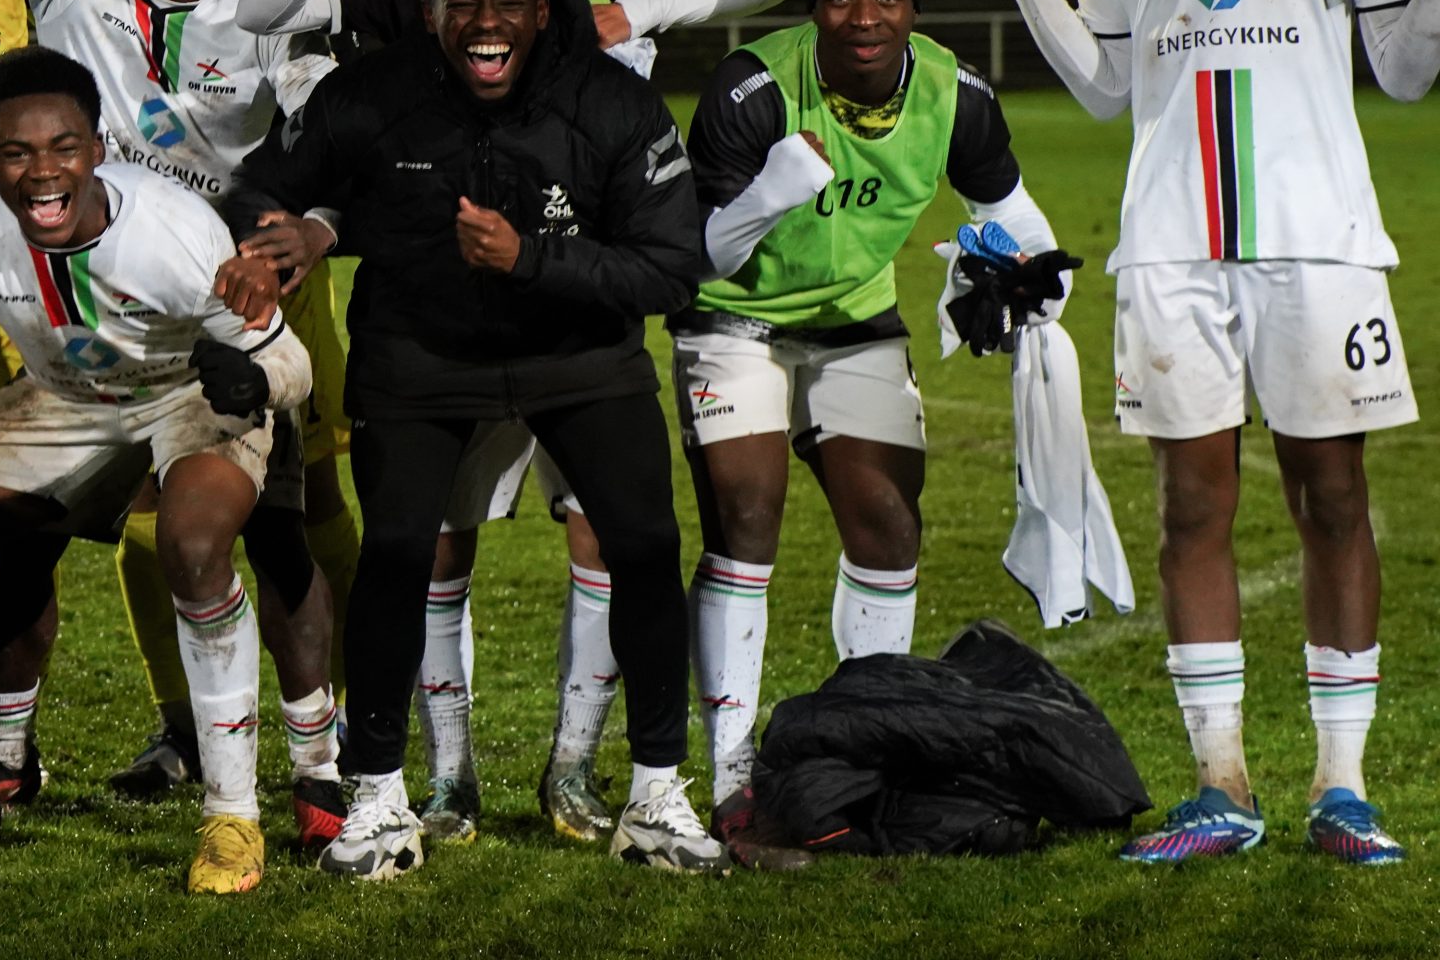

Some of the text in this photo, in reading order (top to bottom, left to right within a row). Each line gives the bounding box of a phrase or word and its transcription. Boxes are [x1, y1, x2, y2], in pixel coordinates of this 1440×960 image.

[1156, 26, 1301, 57] ENERGYKING
[187, 81, 237, 95] OH LEUVEN
[543, 203, 575, 219] OHL
[1344, 317, 1391, 371] 63
